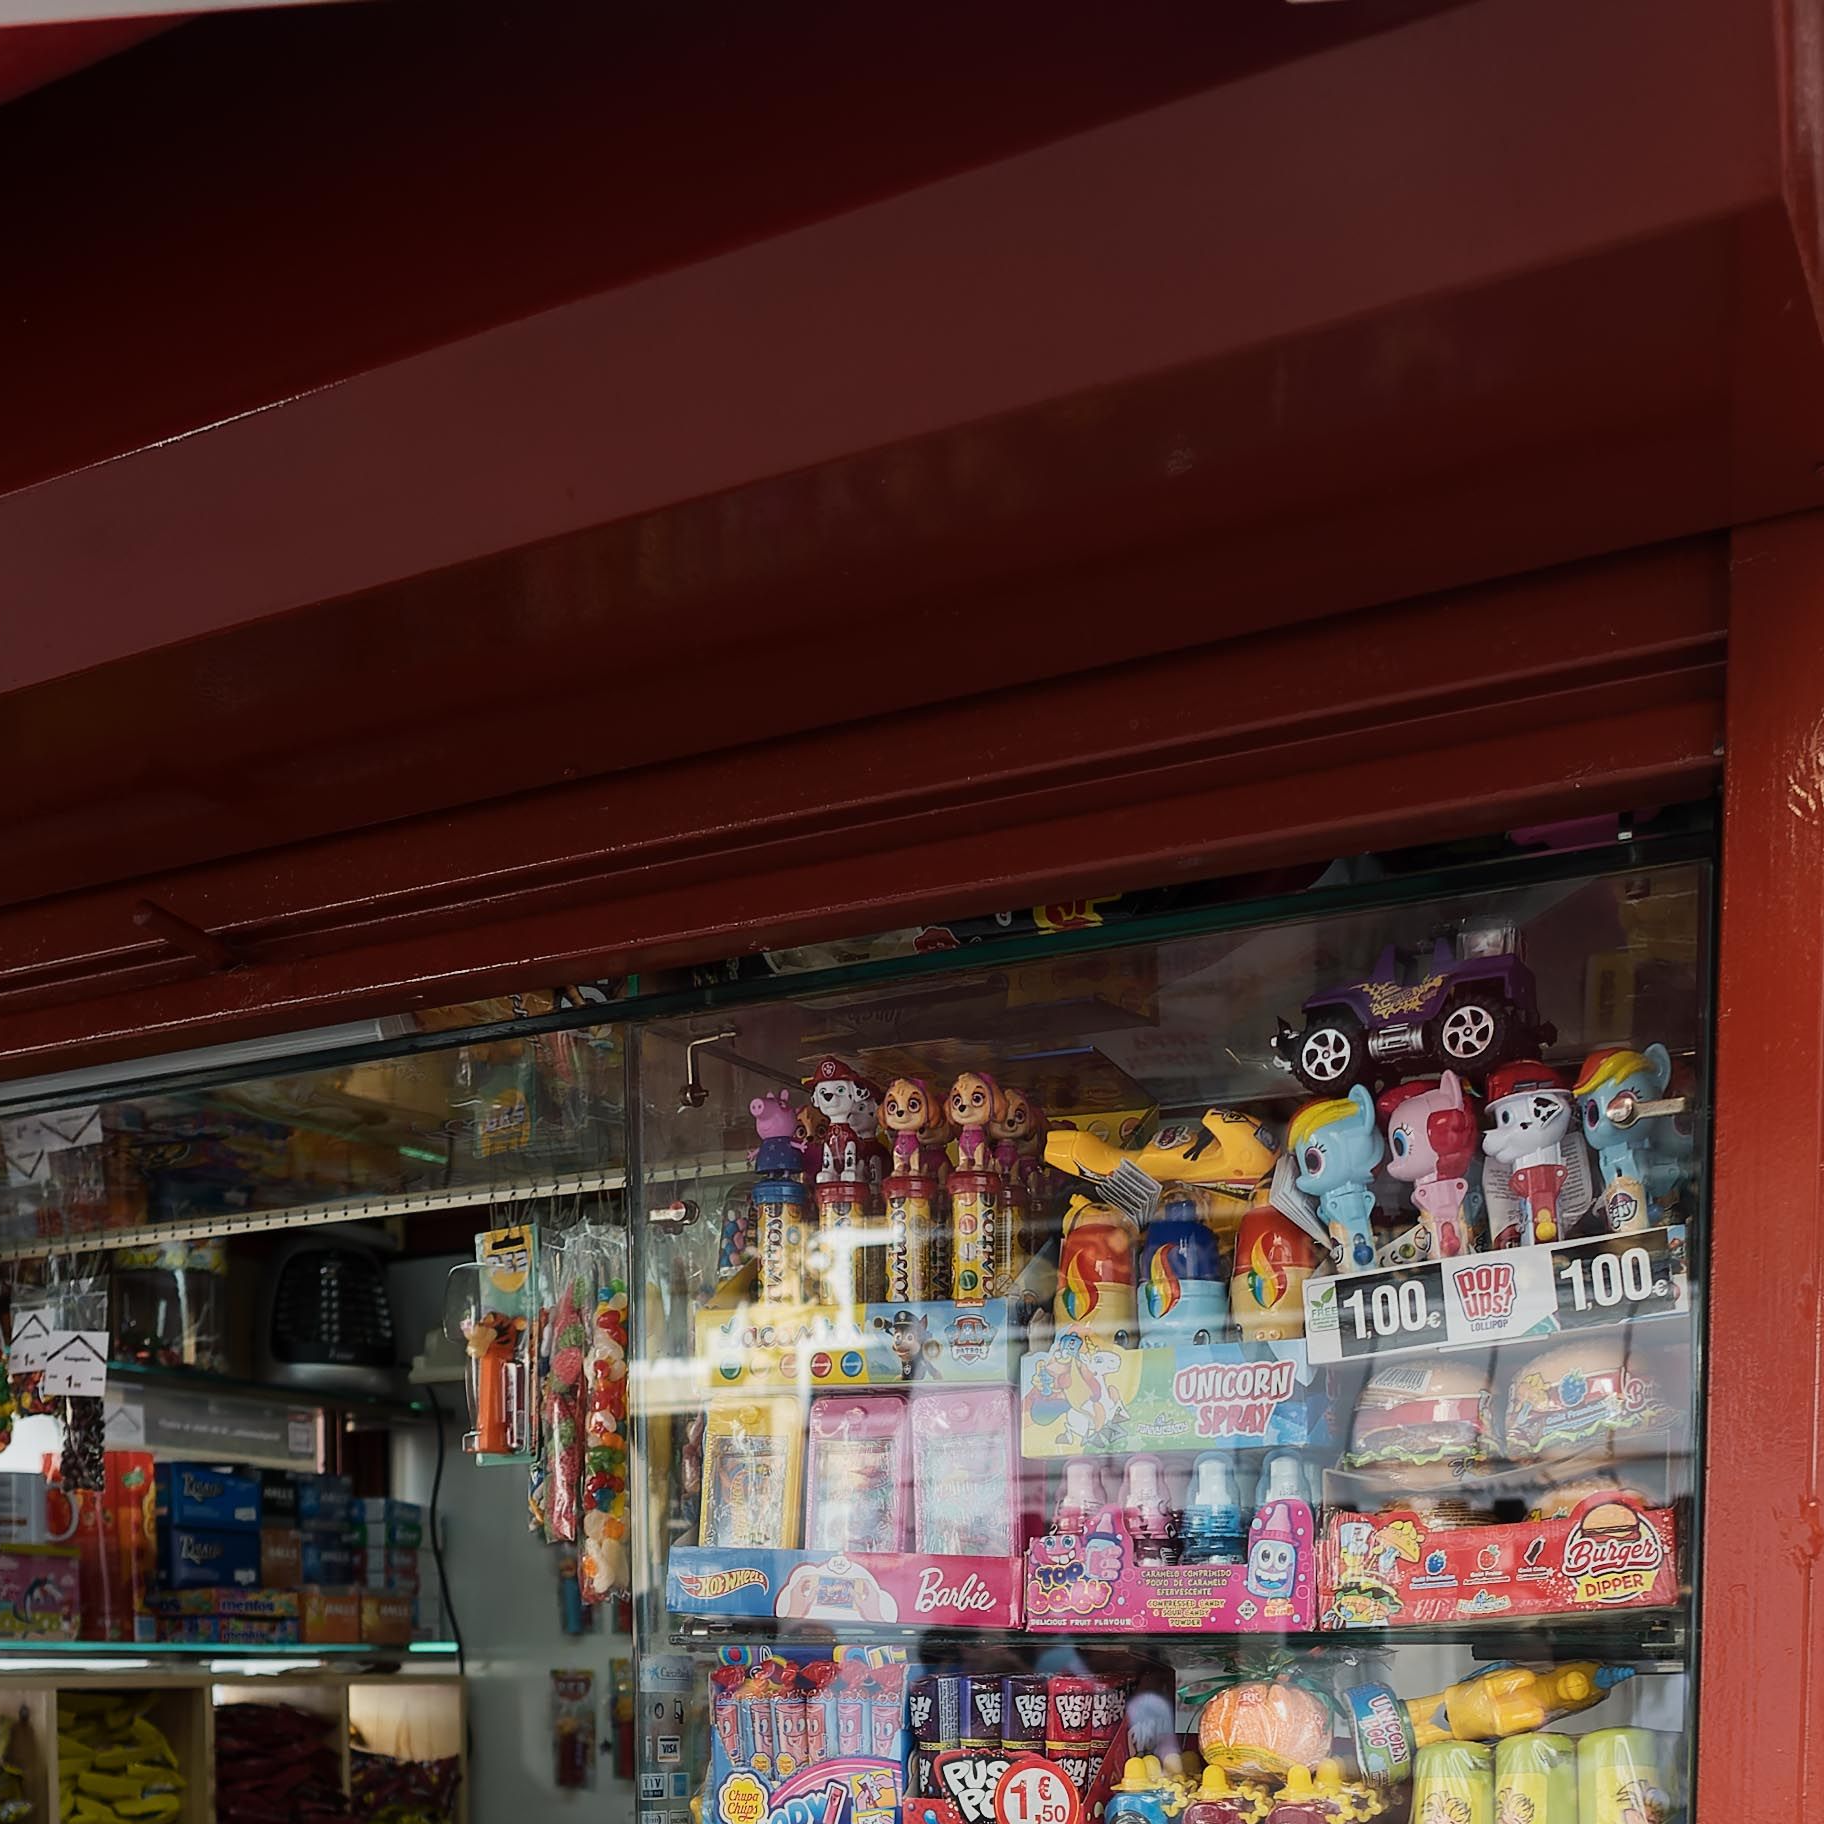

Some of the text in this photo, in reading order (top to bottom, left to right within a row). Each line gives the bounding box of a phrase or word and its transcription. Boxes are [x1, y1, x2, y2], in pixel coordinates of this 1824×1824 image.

[1457, 1266, 1513, 1296] pop
[1471, 1319, 1508, 1332] LOLLIPOP
[1178, 1363, 1293, 1401] UNICORN
[1198, 1402, 1275, 1435] SPRAY
[1565, 1539, 1657, 1573] Burger
[915, 1567, 996, 1612] Barbie
[1585, 1574, 1644, 1597] DIPPER
[729, 1790, 759, 1804] Chupa
